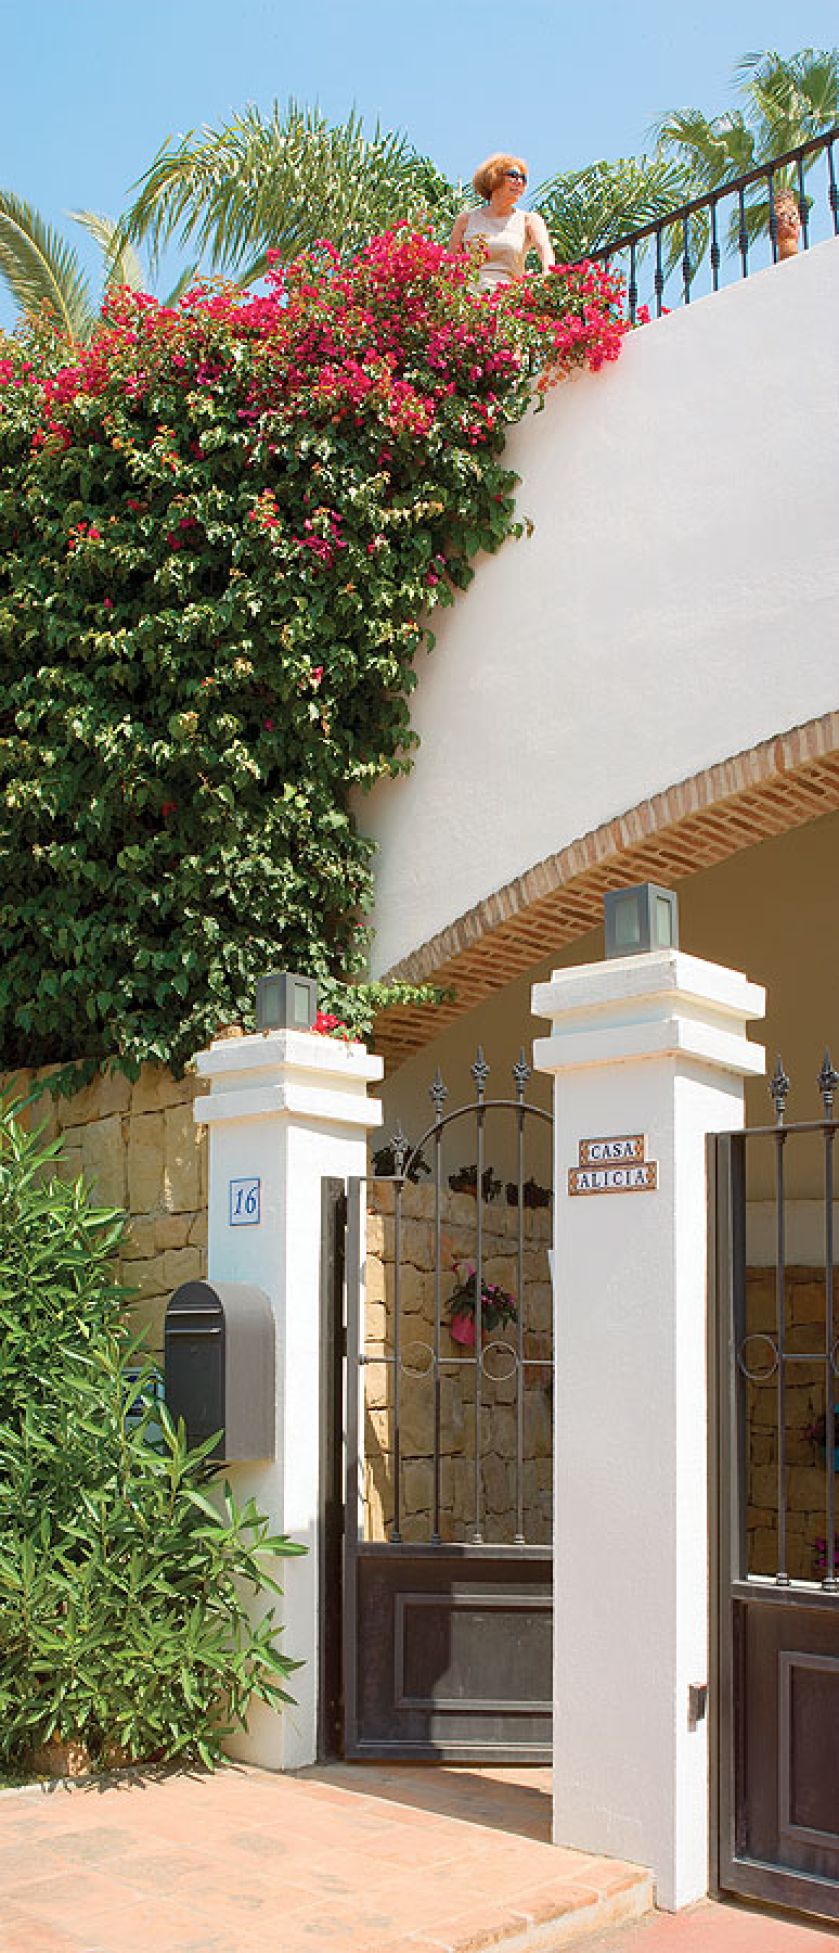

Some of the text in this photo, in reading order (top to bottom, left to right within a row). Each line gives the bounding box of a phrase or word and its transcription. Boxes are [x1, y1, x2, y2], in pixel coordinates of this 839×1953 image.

[591, 1142, 634, 1159] CASA
[580, 1170, 645, 1188] ALICIA
[233, 1186, 258, 1215] 16
